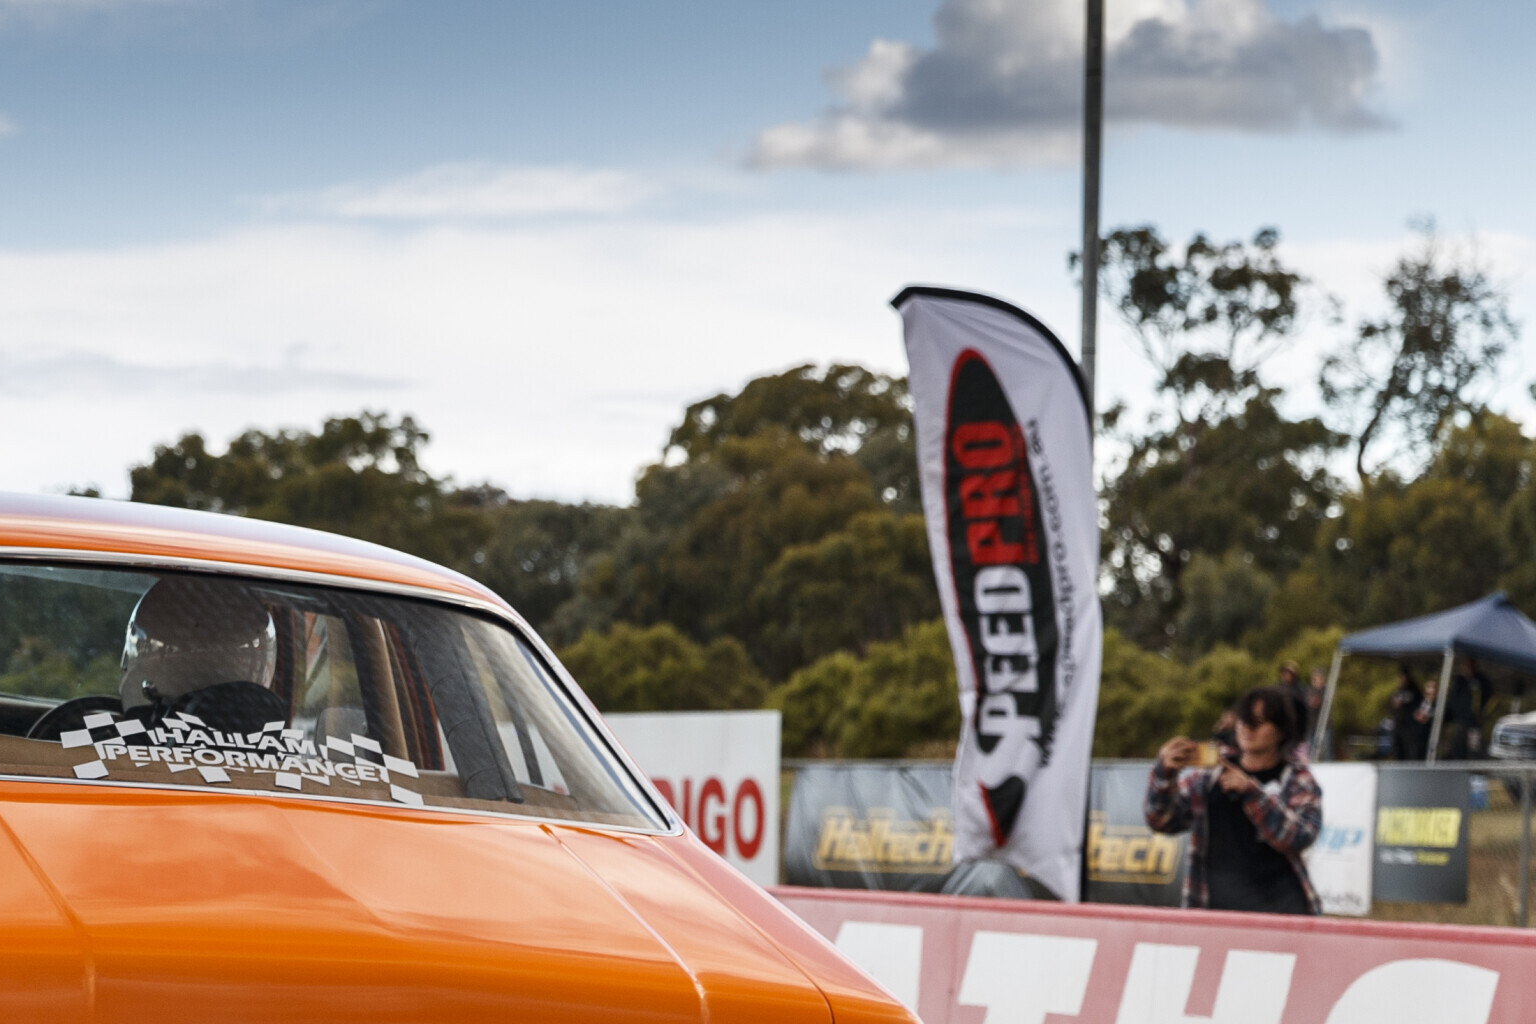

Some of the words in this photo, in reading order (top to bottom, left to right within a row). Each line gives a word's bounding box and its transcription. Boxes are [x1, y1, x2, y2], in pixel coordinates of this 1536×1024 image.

[104, 744, 380, 783] PERFORMANCE
[155, 727, 317, 757] HALLAM
[650, 777, 765, 860] IGO
[1087, 821, 1176, 873] tech
